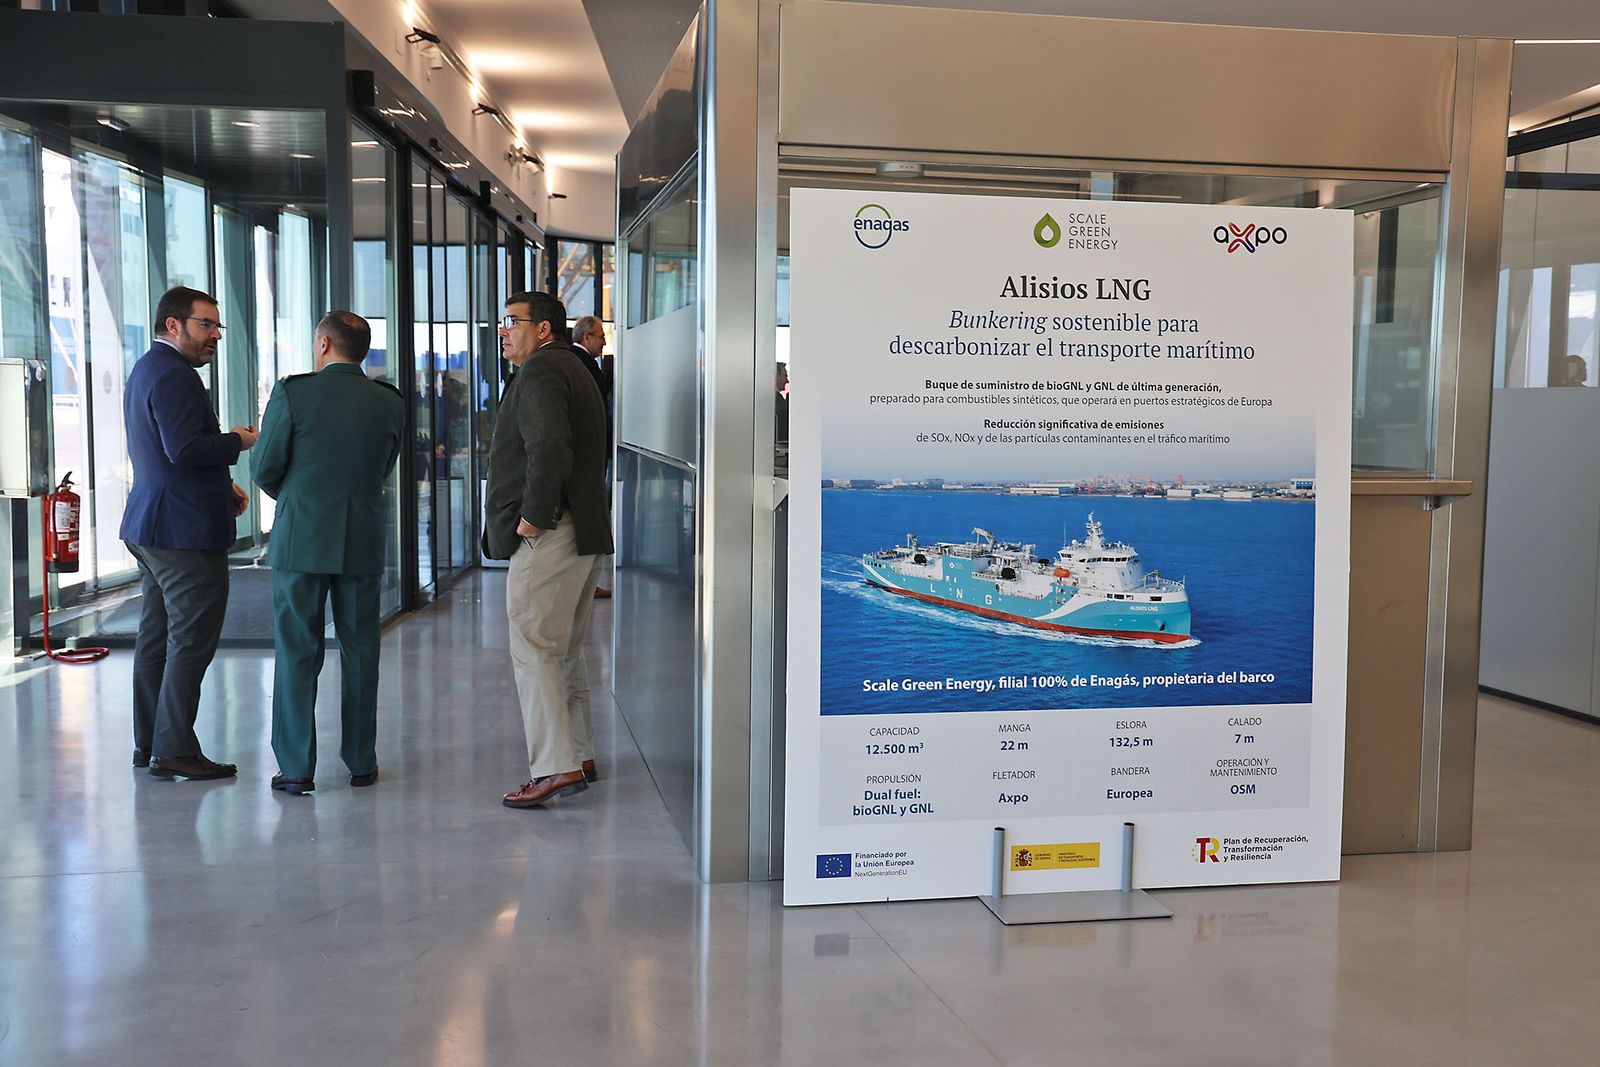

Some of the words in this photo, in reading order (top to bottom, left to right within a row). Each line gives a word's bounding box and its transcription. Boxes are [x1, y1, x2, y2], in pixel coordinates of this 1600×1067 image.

[853, 218, 910, 232] enagas
[1068, 213, 1106, 225] SCALE
[1068, 225, 1110, 238] GREEN
[1068, 238, 1118, 250] ENERGY
[1212, 222, 1288, 254] axpo
[999, 274, 1088, 299] Alisios
[1095, 278, 1151, 300] LNG
[948, 309, 1048, 334] Bunkering
[1052, 312, 1151, 331] sostenible
[1157, 318, 1198, 336] para
[889, 334, 1030, 356] descarbonizar
[1036, 337, 1053, 357] el
[1058, 340, 1162, 362] transporte
[1166, 339, 1254, 359] marítimo
[925, 379, 958, 391] Buque
[960, 379, 974, 390] de
[975, 380, 1030, 390] suministro
[1031, 380, 1044, 390] de
[1046, 380, 1084, 390] bioGNL
[1085, 383, 1092, 392] y
[1093, 381, 1114, 390] GNL
[1116, 381, 1129, 391] de
[1131, 381, 1162, 391] última
[1164, 382, 1222, 393] generación,
[869, 393, 920, 405] preparado
[921, 394, 944, 405] para
[946, 394, 1010, 404] combustibles
[1012, 394, 1059, 405] sintéticos,
[1061, 397, 1079, 406] que
[1080, 395, 1118, 406] operará
[1133, 396, 1169, 407] puertos
[1169, 396, 1225, 408] estratégicos
[1226, 396, 1239, 406] de
[1240, 395, 1272, 408] Europa
[984, 418, 1036, 428] Reducción
[1038, 419, 1098, 431] significativa
[1100, 419, 1113, 429] de
[1114, 419, 1164, 429] emisiones
[916, 432, 928, 443] de
[930, 432, 952, 443] SOx,
[953, 432, 975, 442] NOx
[977, 435, 983, 445] y
[984, 432, 997, 443] de
[998, 432, 1012, 442] las
[1014, 433, 1060, 444] partículas
[1062, 433, 1131, 444] contaminantes
[1147, 433, 1155, 443] el
[1157, 433, 1187, 443] tráfico
[1188, 434, 1230, 443] marítimo
[862, 678, 899, 691] Scale
[901, 678, 942, 690] Green
[945, 677, 996, 692] Energy,
[998, 675, 1027, 688] filial
[1030, 675, 1068, 688] 100%
[1070, 674, 1087, 686] de
[1090, 673, 1140, 689] Enagás,
[1142, 671, 1214, 688] propietaria
[1216, 671, 1236, 683] del
[1239, 670, 1274, 683] barco
[998, 723, 1031, 732] MANGA
[1116, 719, 1147, 730] ESLORA
[1227, 717, 1262, 726] CALADO
[869, 726, 920, 736] CAPACIDAD
[1109, 736, 1139, 748] 132,5
[1142, 738, 1153, 746] m
[1234, 733, 1241, 743] 7
[865, 743, 905, 755] 12.500
[908, 742, 923, 753] m³
[1000, 740, 1014, 750] 22
[1017, 742, 1028, 750] m
[1216, 757, 1263, 768] OPERACIÓN
[1264, 758, 1270, 766] Y
[992, 769, 1036, 779] FLETADOR
[1110, 765, 1150, 776] BANDERA
[1209, 766, 1278, 777] MANTENIMIENTO
[866, 772, 921, 784] PROPULSIÓN
[864, 789, 891, 800] Dual
[894, 788, 920, 799] fuel:
[1106, 788, 1152, 800] Europea
[1230, 784, 1255, 794] OSM
[998, 792, 1028, 805] Axpo
[852, 804, 897, 816] bioGNL
[899, 806, 907, 816] y
[909, 802, 934, 813] GNL
[1254, 834, 1309, 844] Recuperación,
[1222, 844, 1284, 854] Transformación
[1223, 854, 1229, 862] y
[1230, 852, 1272, 861] Resiliencia
[854, 869, 908, 877] NextGenerationEU
